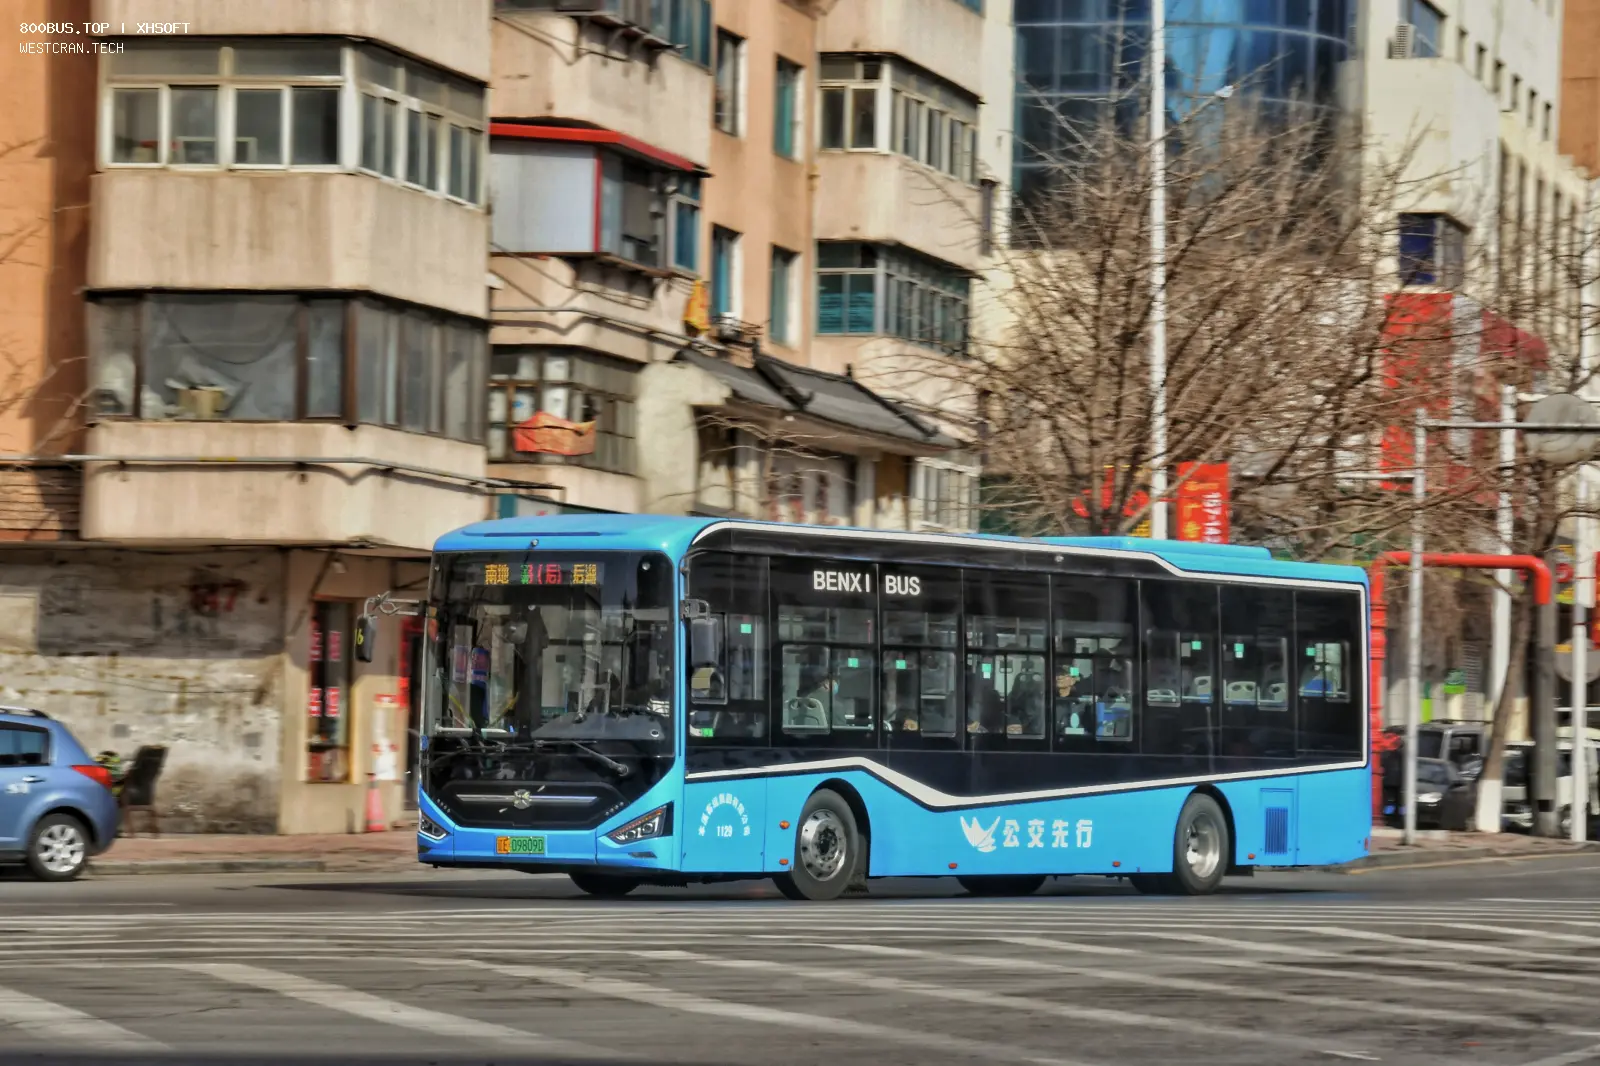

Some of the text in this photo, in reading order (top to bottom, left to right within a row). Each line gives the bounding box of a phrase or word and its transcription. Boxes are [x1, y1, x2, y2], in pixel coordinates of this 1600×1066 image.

[813, 570, 921, 596] BENXI BUS
[1002, 818, 1093, 849] 公交先行
